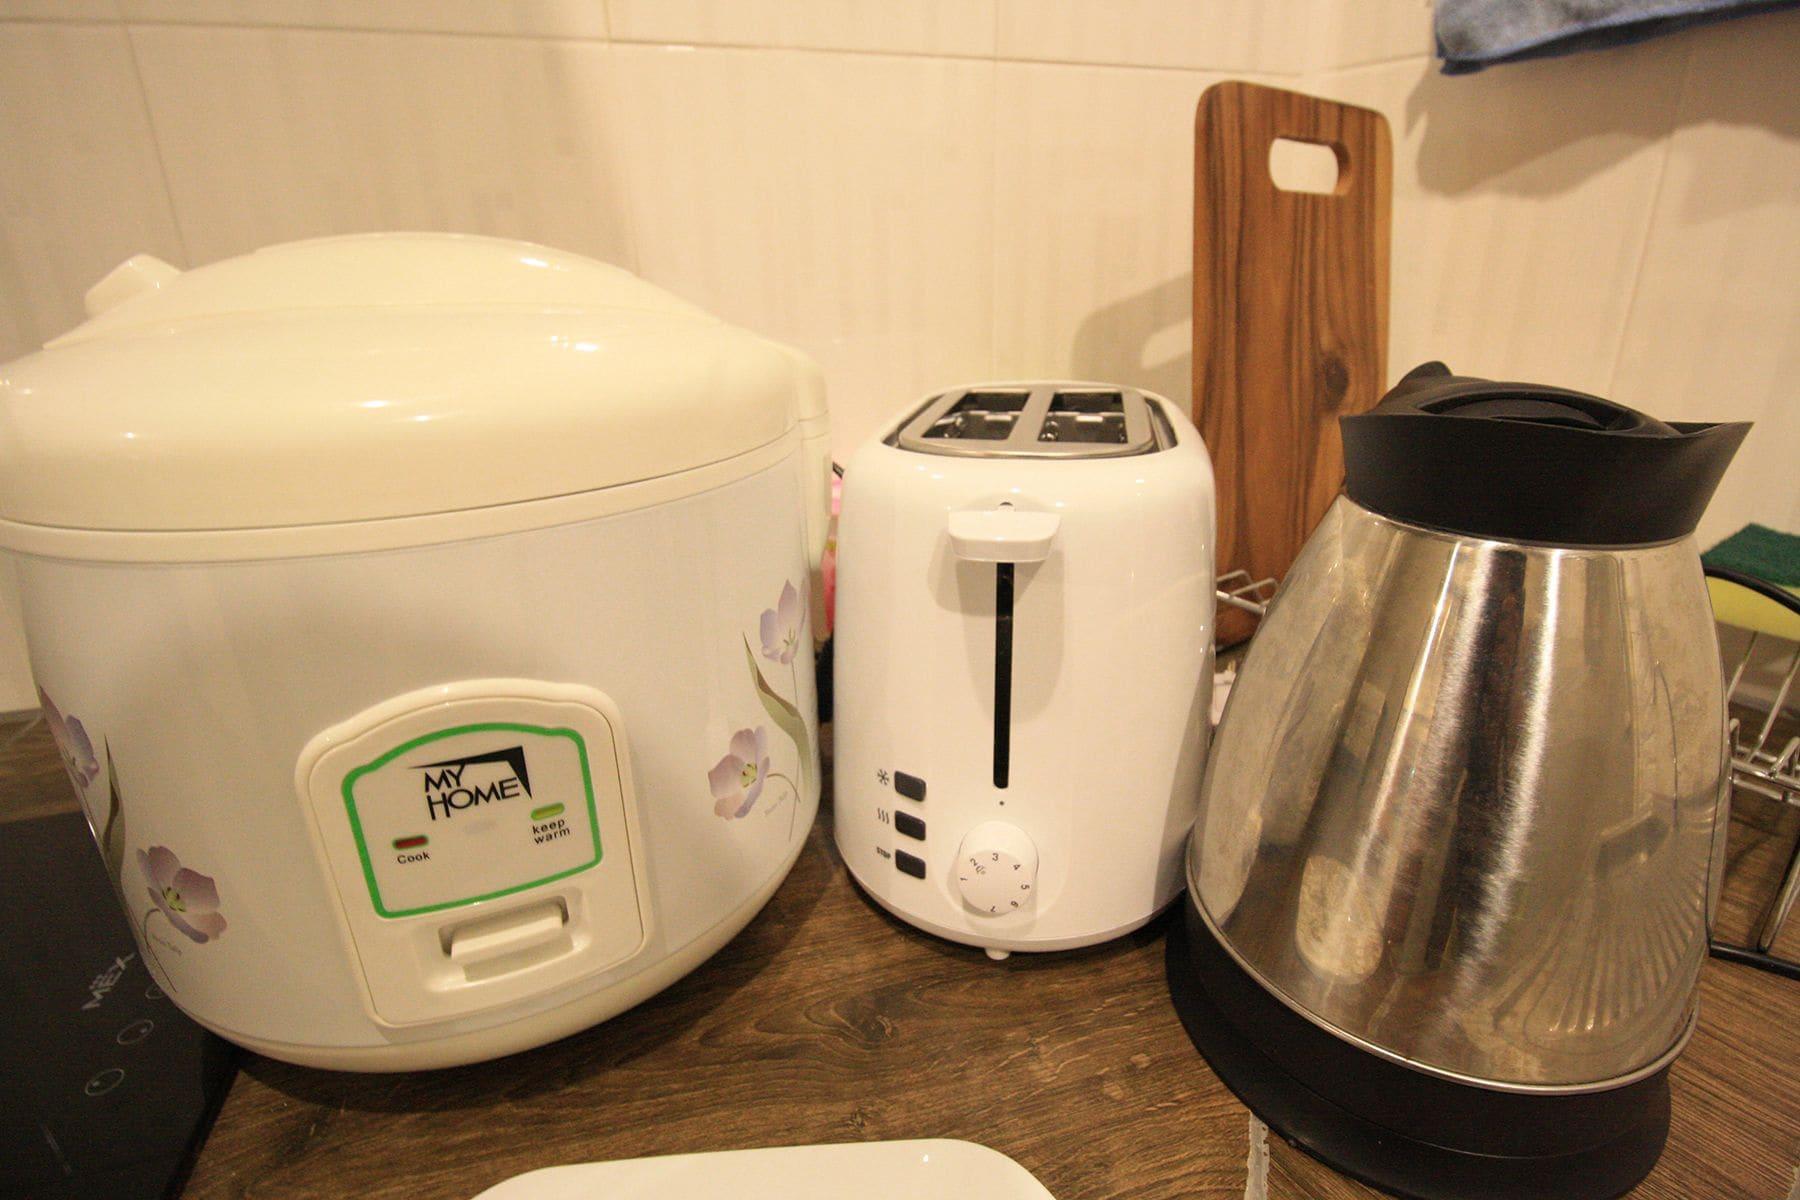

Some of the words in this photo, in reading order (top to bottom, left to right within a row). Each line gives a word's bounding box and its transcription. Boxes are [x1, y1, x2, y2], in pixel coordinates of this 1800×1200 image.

[424, 763, 467, 793] MY
[426, 776, 521, 821] HOME
[532, 818, 566, 835] keep
[533, 827, 571, 845] warm
[396, 851, 431, 865] Cook
[969, 857, 978, 867] 2
[992, 852, 999, 862] 3
